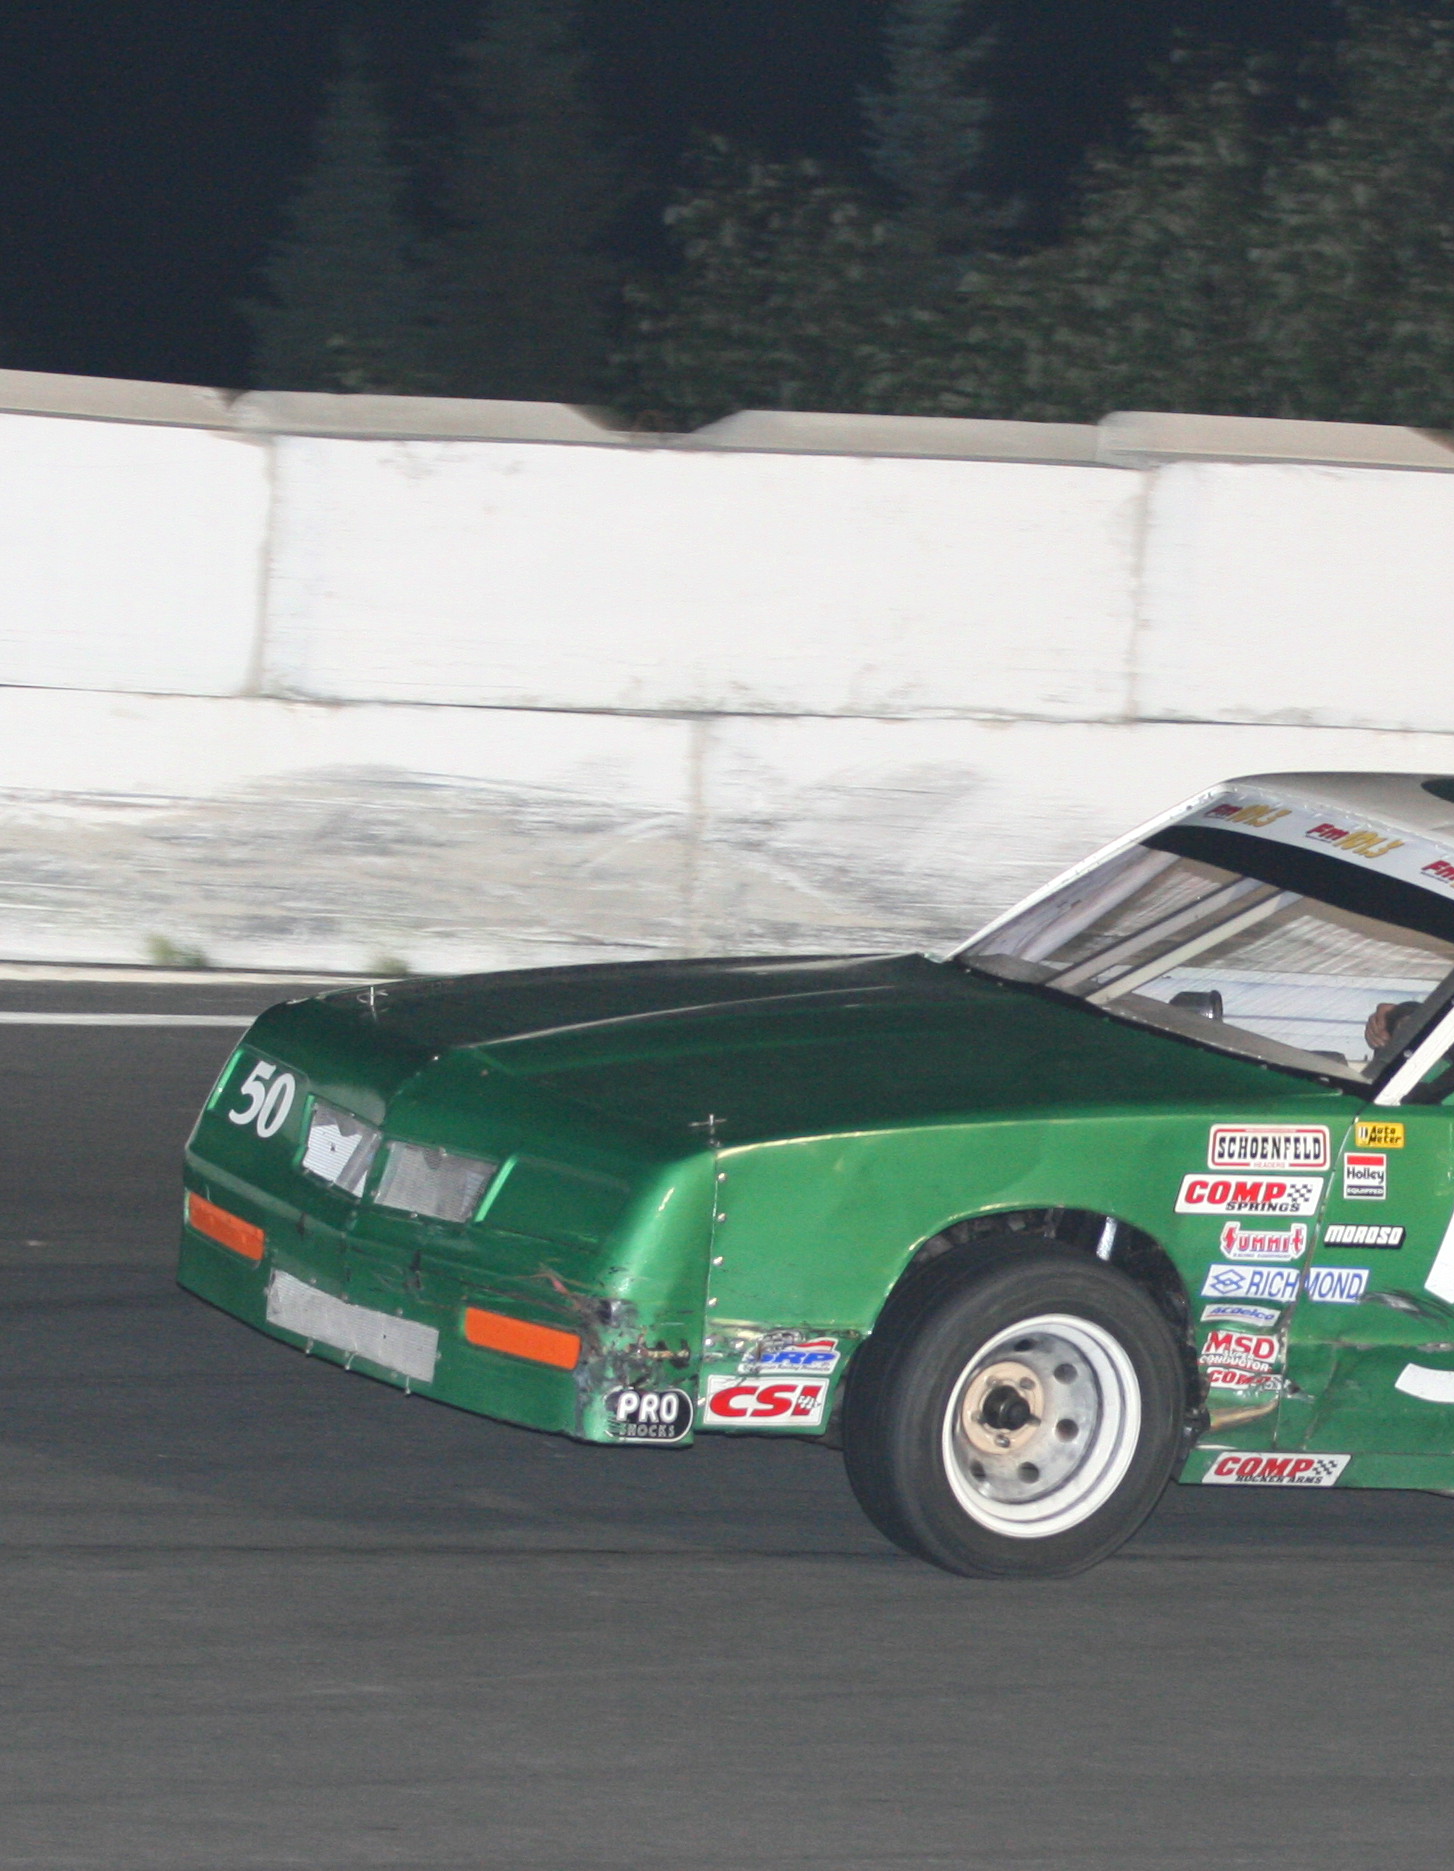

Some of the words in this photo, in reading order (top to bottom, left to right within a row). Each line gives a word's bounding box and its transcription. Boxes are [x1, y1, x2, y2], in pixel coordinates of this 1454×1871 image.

[228, 1060, 296, 1138] 50
[1217, 1136, 1321, 1160] SCHOENFELD
[1346, 1166, 1385, 1185] Holley
[1184, 1180, 1287, 1205] COMP
[1225, 1201, 1301, 1212] SPRINGS
[1324, 1224, 1404, 1245] MOROSO
[1245, 1268, 1364, 1301] RICHMOND
[1205, 1331, 1275, 1359] MSD
[616, 1390, 680, 1424] PRO
[1213, 1455, 1316, 1477] COMP
